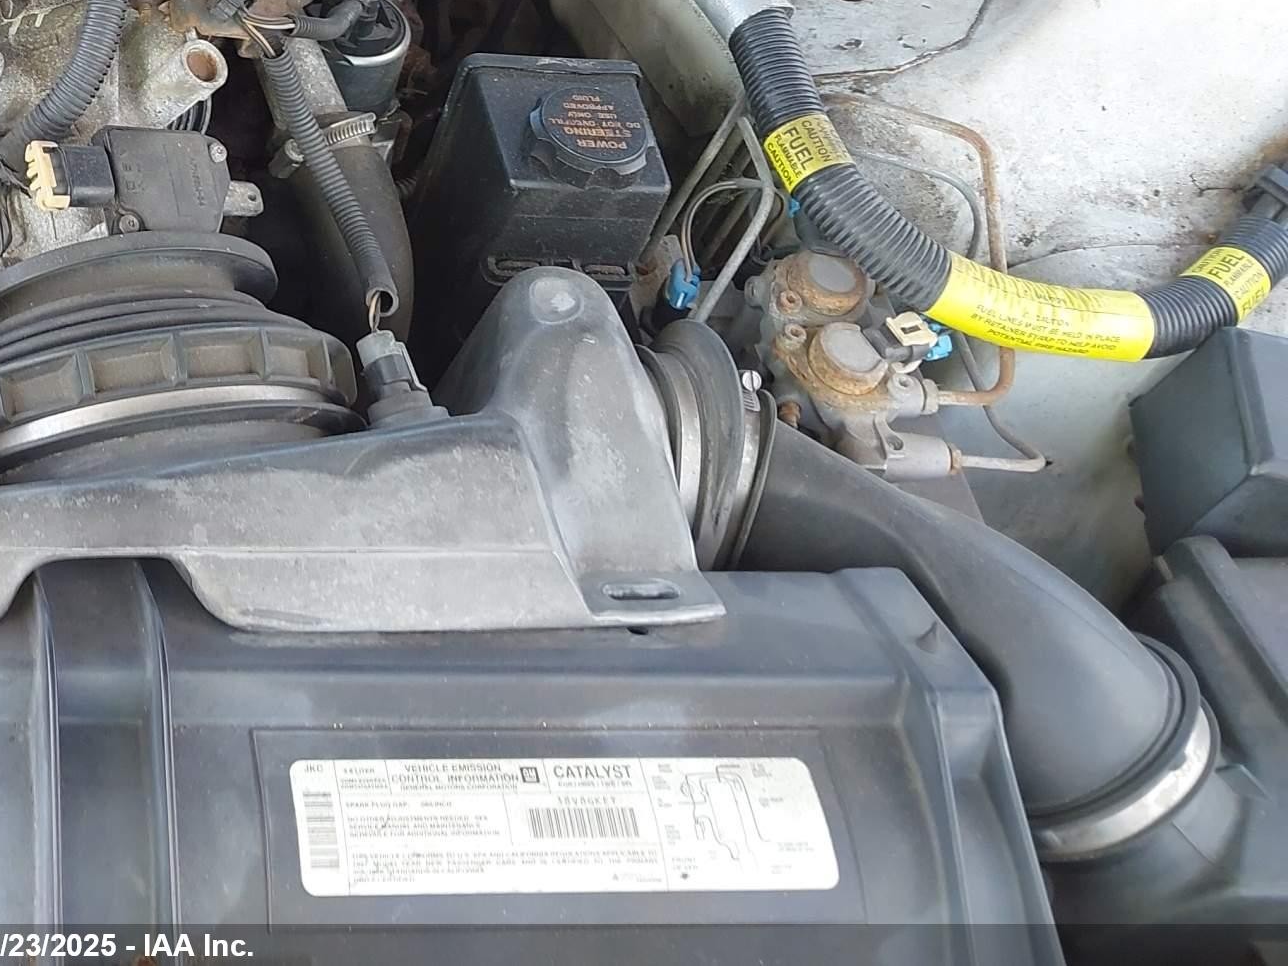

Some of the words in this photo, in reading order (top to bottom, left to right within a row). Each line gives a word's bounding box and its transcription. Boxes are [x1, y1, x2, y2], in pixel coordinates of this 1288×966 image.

[572, 94, 601, 102] FLUID
[562, 102, 615, 110] APPROVED
[548, 117, 596, 127] OVERFILL
[600, 120, 623, 128] NOT
[627, 121, 641, 129] DO
[564, 126, 633, 138] STEERING
[577, 138, 627, 150] POWER
[783, 126, 814, 170] FUEL
[801, 120, 832, 162] CAUTION
[774, 134, 802, 178] FLAMMABLE
[767, 143, 794, 185] CAUTION
[1208, 254, 1244, 279] FUEL
[1234, 270, 1265, 299] CAUTION
[976, 304, 997, 315] FUEL
[998, 312, 1023, 326] LINES
[1024, 321, 1048, 331] MUST
[1062, 330, 1082, 339] HELD
[1095, 335, 1121, 343] PLACE
[970, 313, 983, 321] BY
[983, 317, 1026, 336] RETAINER
[1092, 342, 1117, 350] AVOID
[987, 328, 1032, 346] POTENTIAL
[404, 763, 449, 773] VEHICLE
[451, 763, 502, 772] EMISSION
[553, 764, 632, 779] CATALYST
[391, 774, 440, 783] CONTROL
[447, 773, 520, 783] INFORMATION
